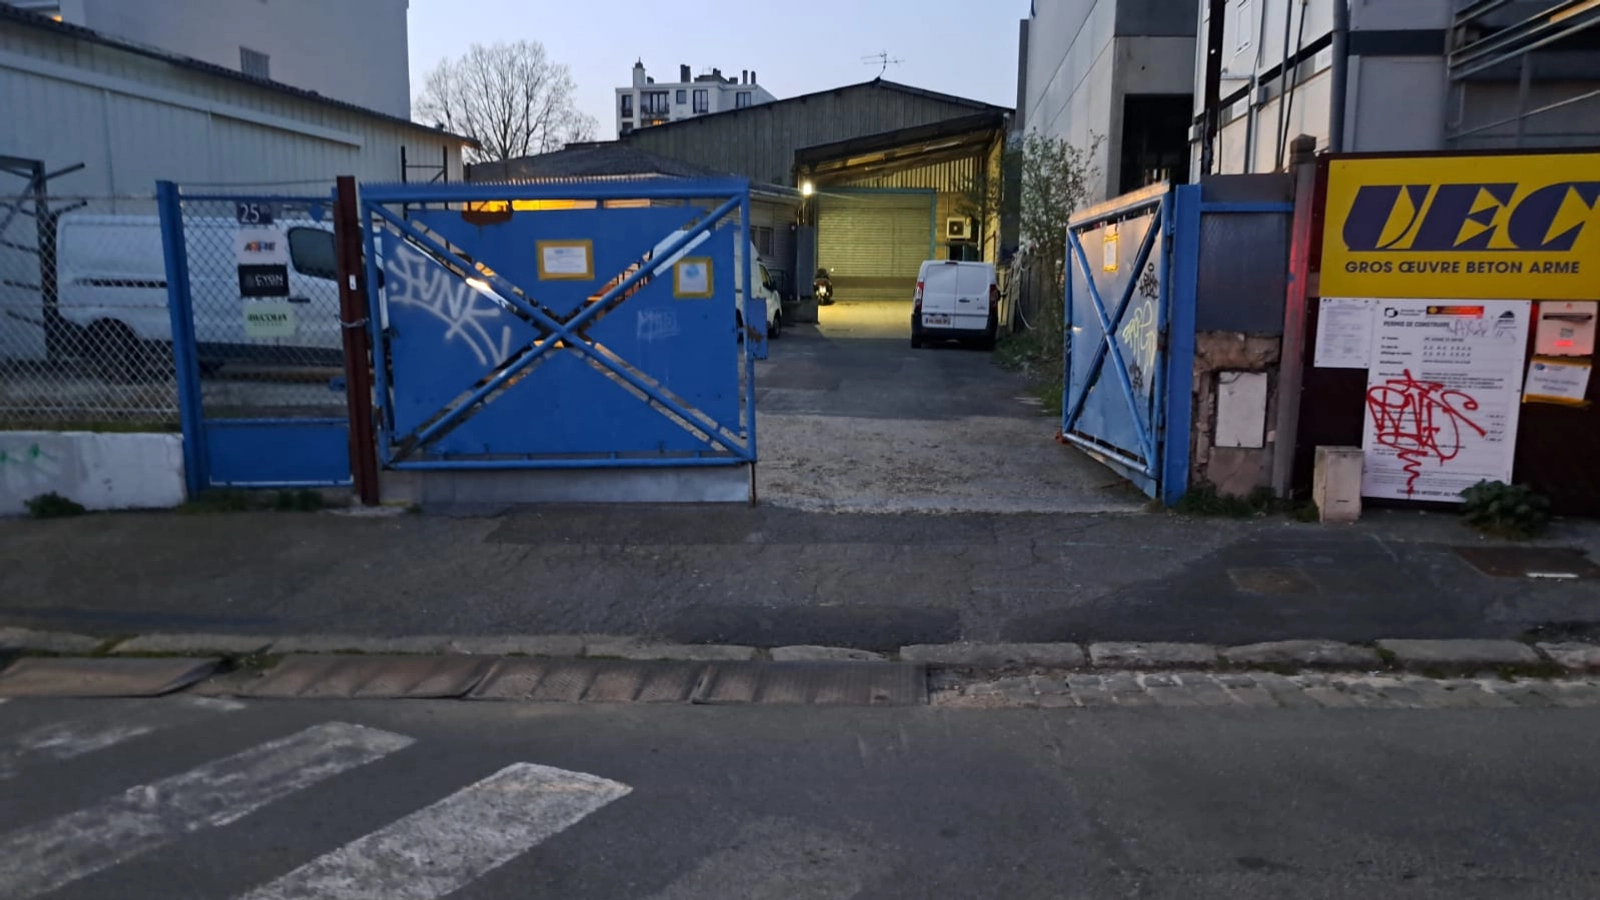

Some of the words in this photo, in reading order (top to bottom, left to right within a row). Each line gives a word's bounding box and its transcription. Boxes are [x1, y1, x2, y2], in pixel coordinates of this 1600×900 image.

[240, 203, 260, 223] 25
[1342, 181, 1600, 251] UEC
[1345, 261, 1393, 273] GROS
[1398, 261, 1460, 273] ŒUVRE
[1466, 261, 1523, 274] BETON
[1529, 261, 1580, 274] ARME
